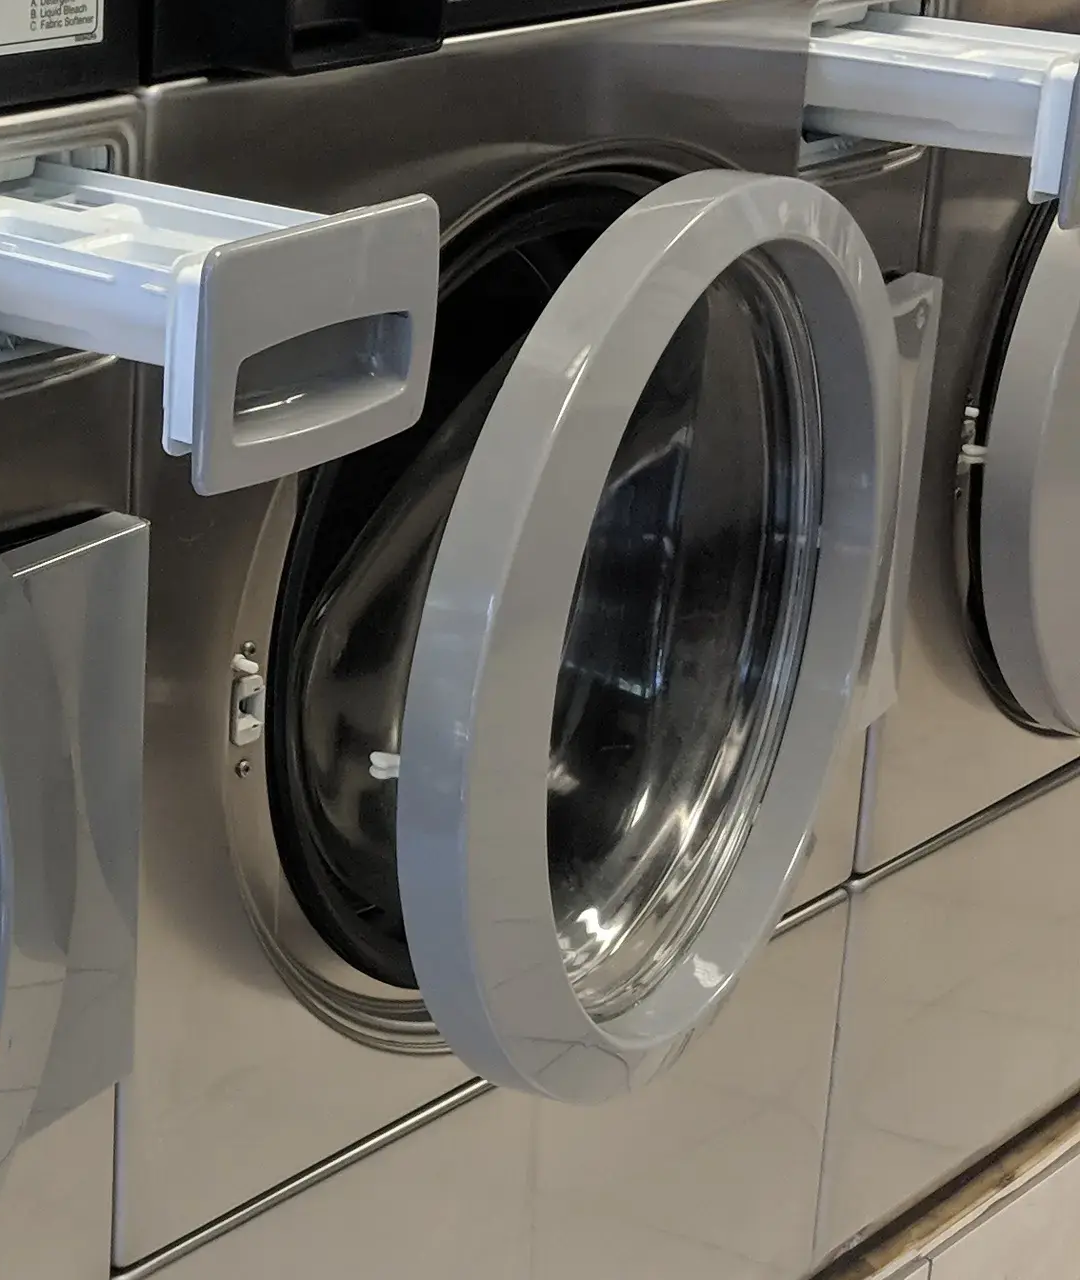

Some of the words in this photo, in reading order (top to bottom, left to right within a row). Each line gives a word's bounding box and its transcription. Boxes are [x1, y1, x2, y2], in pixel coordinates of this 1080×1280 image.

[63, 4, 88, 15] Bleach
[40, 19, 63, 29] Fabric
[64, 15, 94, 27] Softener
